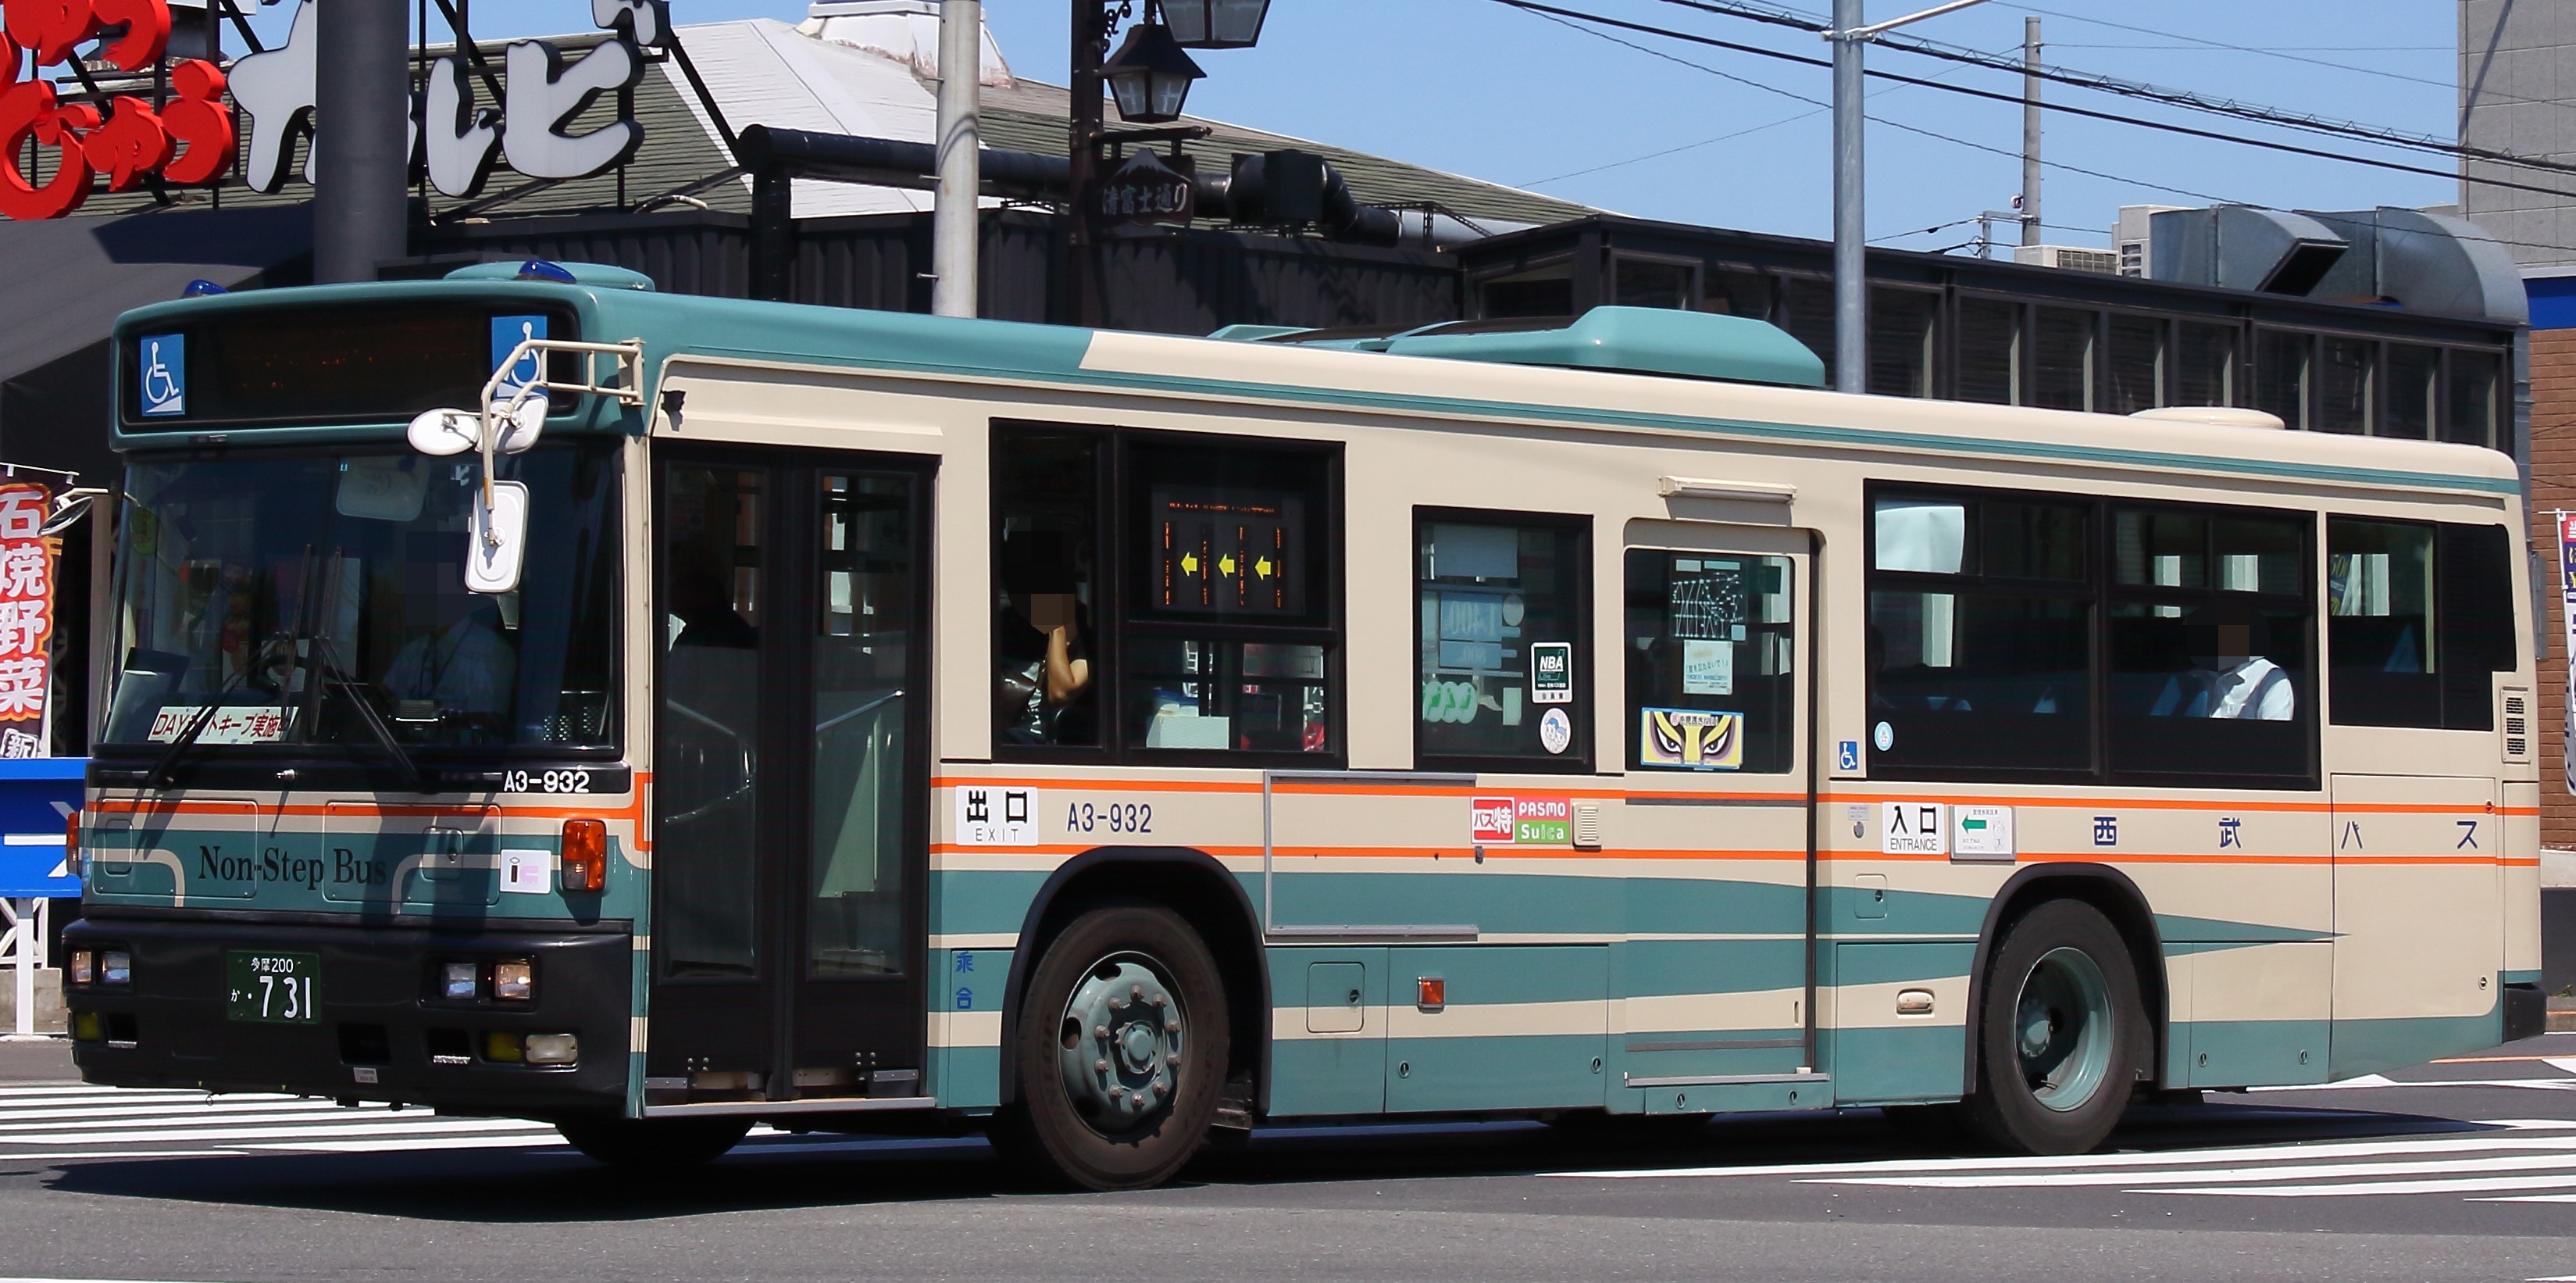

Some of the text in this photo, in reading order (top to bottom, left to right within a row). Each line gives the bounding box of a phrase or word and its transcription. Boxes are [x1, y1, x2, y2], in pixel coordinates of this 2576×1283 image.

[0, 491, 46, 713] 石焼野菜
[1540, 656, 1565, 670] NBA
[504, 770, 590, 793] A3-932
[966, 789, 1029, 824] 出口
[1066, 802, 1153, 834] A3-932
[1518, 802, 1566, 817] PASMO
[1521, 823, 1565, 840] Suica
[1890, 805, 1937, 835] 入口
[975, 827, 1019, 842] EXIT
[1890, 838, 1937, 852] ENTRANCE
[198, 845, 387, 891] Non-Step Bus
